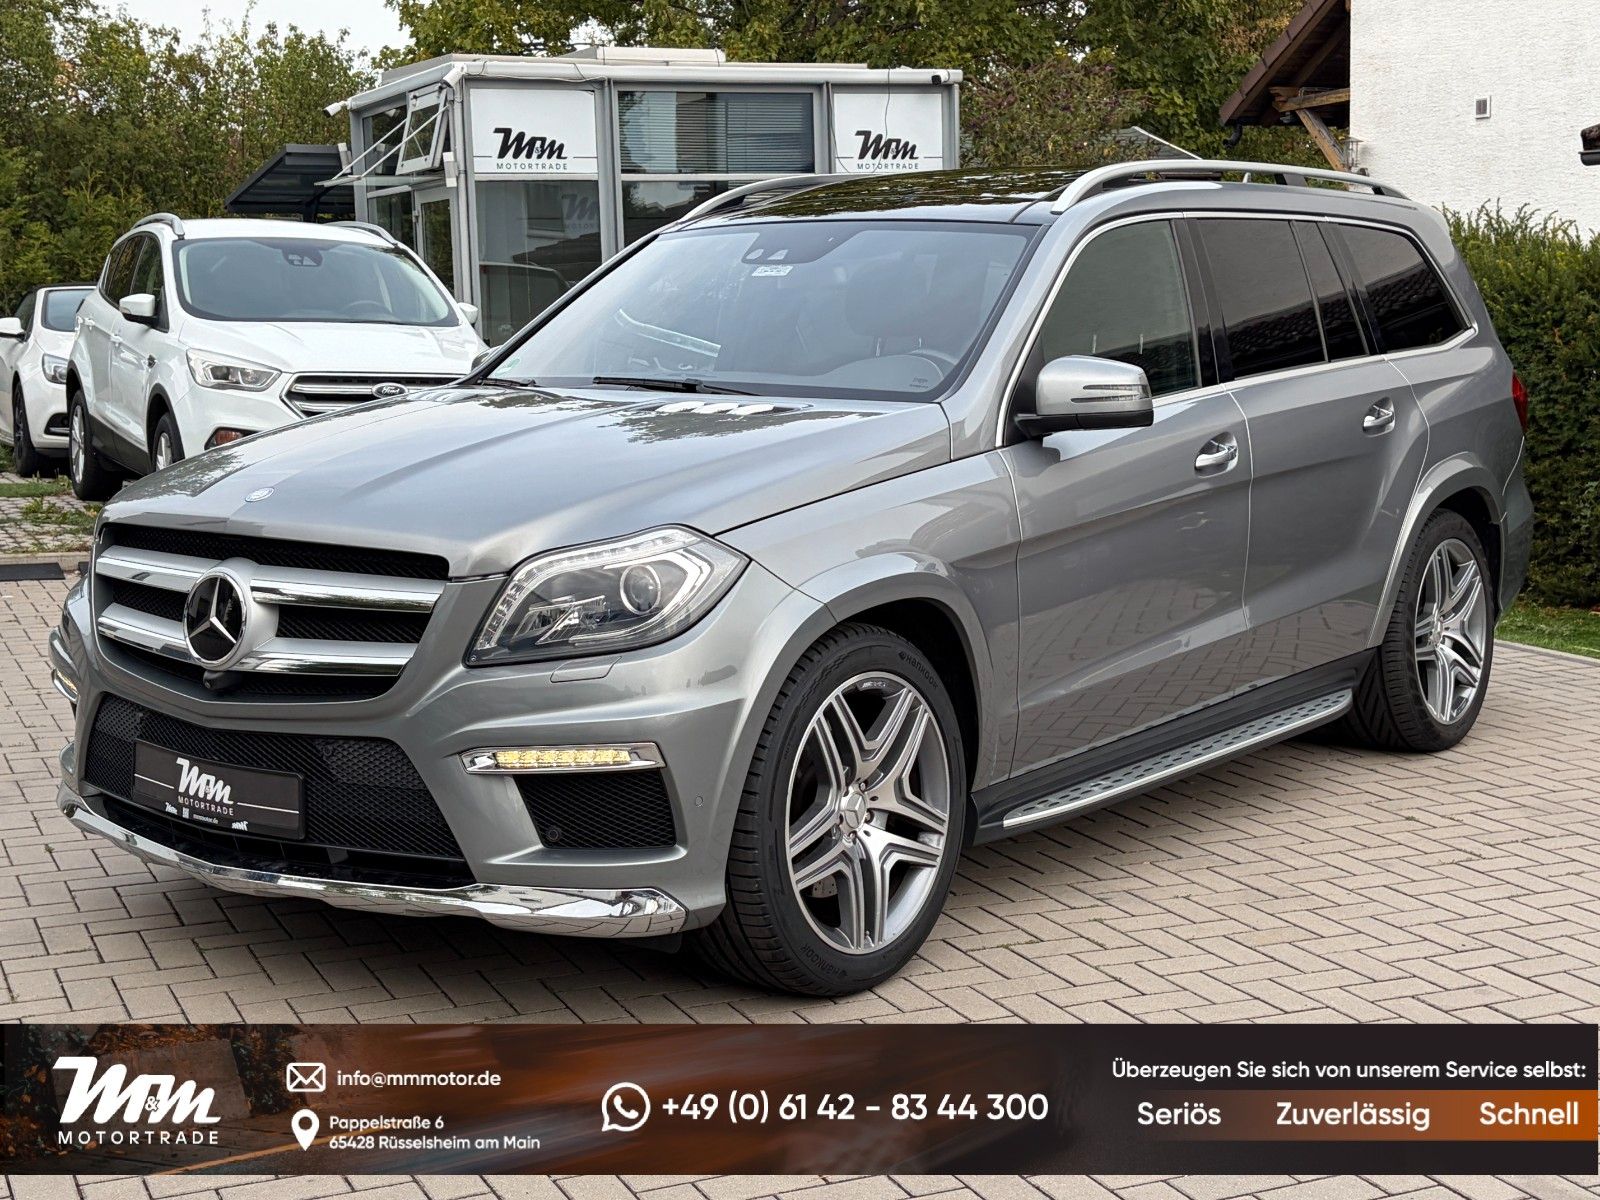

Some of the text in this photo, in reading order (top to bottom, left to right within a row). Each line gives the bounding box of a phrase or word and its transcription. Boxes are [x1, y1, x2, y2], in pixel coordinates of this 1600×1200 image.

[496, 162, 568, 171] MOTORTRADE
[857, 162, 919, 170] MOTORTRADE
[177, 796, 234, 816] MOTORTRADE
